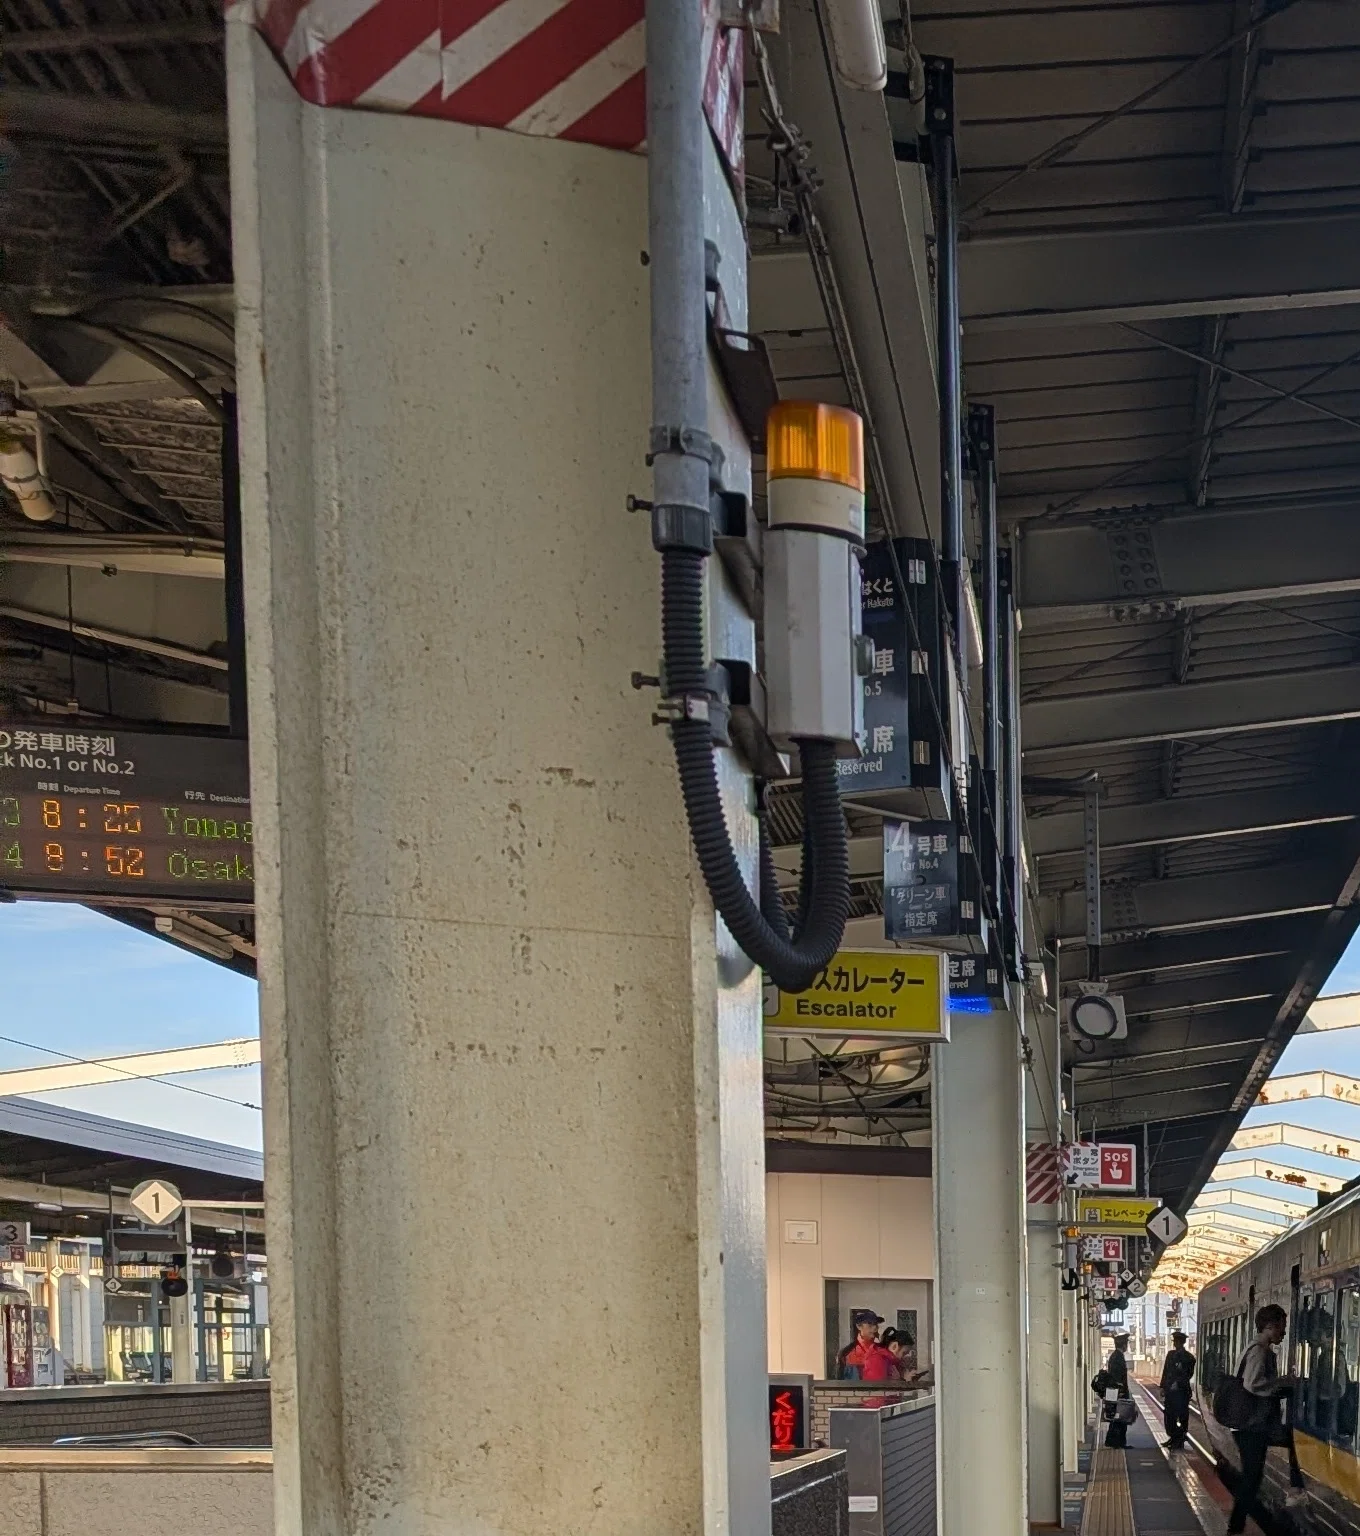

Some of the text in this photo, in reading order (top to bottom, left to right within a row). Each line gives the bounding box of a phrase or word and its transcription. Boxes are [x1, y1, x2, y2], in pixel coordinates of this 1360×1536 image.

[20, 753, 62, 771] No.1
[68, 758, 89, 772] or
[92, 758, 136, 776] No.2
[37, 781, 59, 792] 時刻
[102, 786, 121, 796] Time
[184, 790, 206, 801] 行先
[891, 821, 949, 858] 4号車
[904, 911, 939, 928] 指定席
[810, 965, 925, 995] スカレーター
[796, 999, 897, 1019] Escalator
[1104, 1152, 1129, 1163] SOS
[152, 1192, 160, 1213] 1
[1104, 1208, 1151, 1218] エレベータ
[4, 1224, 18, 1241] 3
[1162, 1215, 1170, 1236] 1
[1133, 1282, 1141, 1293] 2
[772, 1391, 796, 1443] くだり
